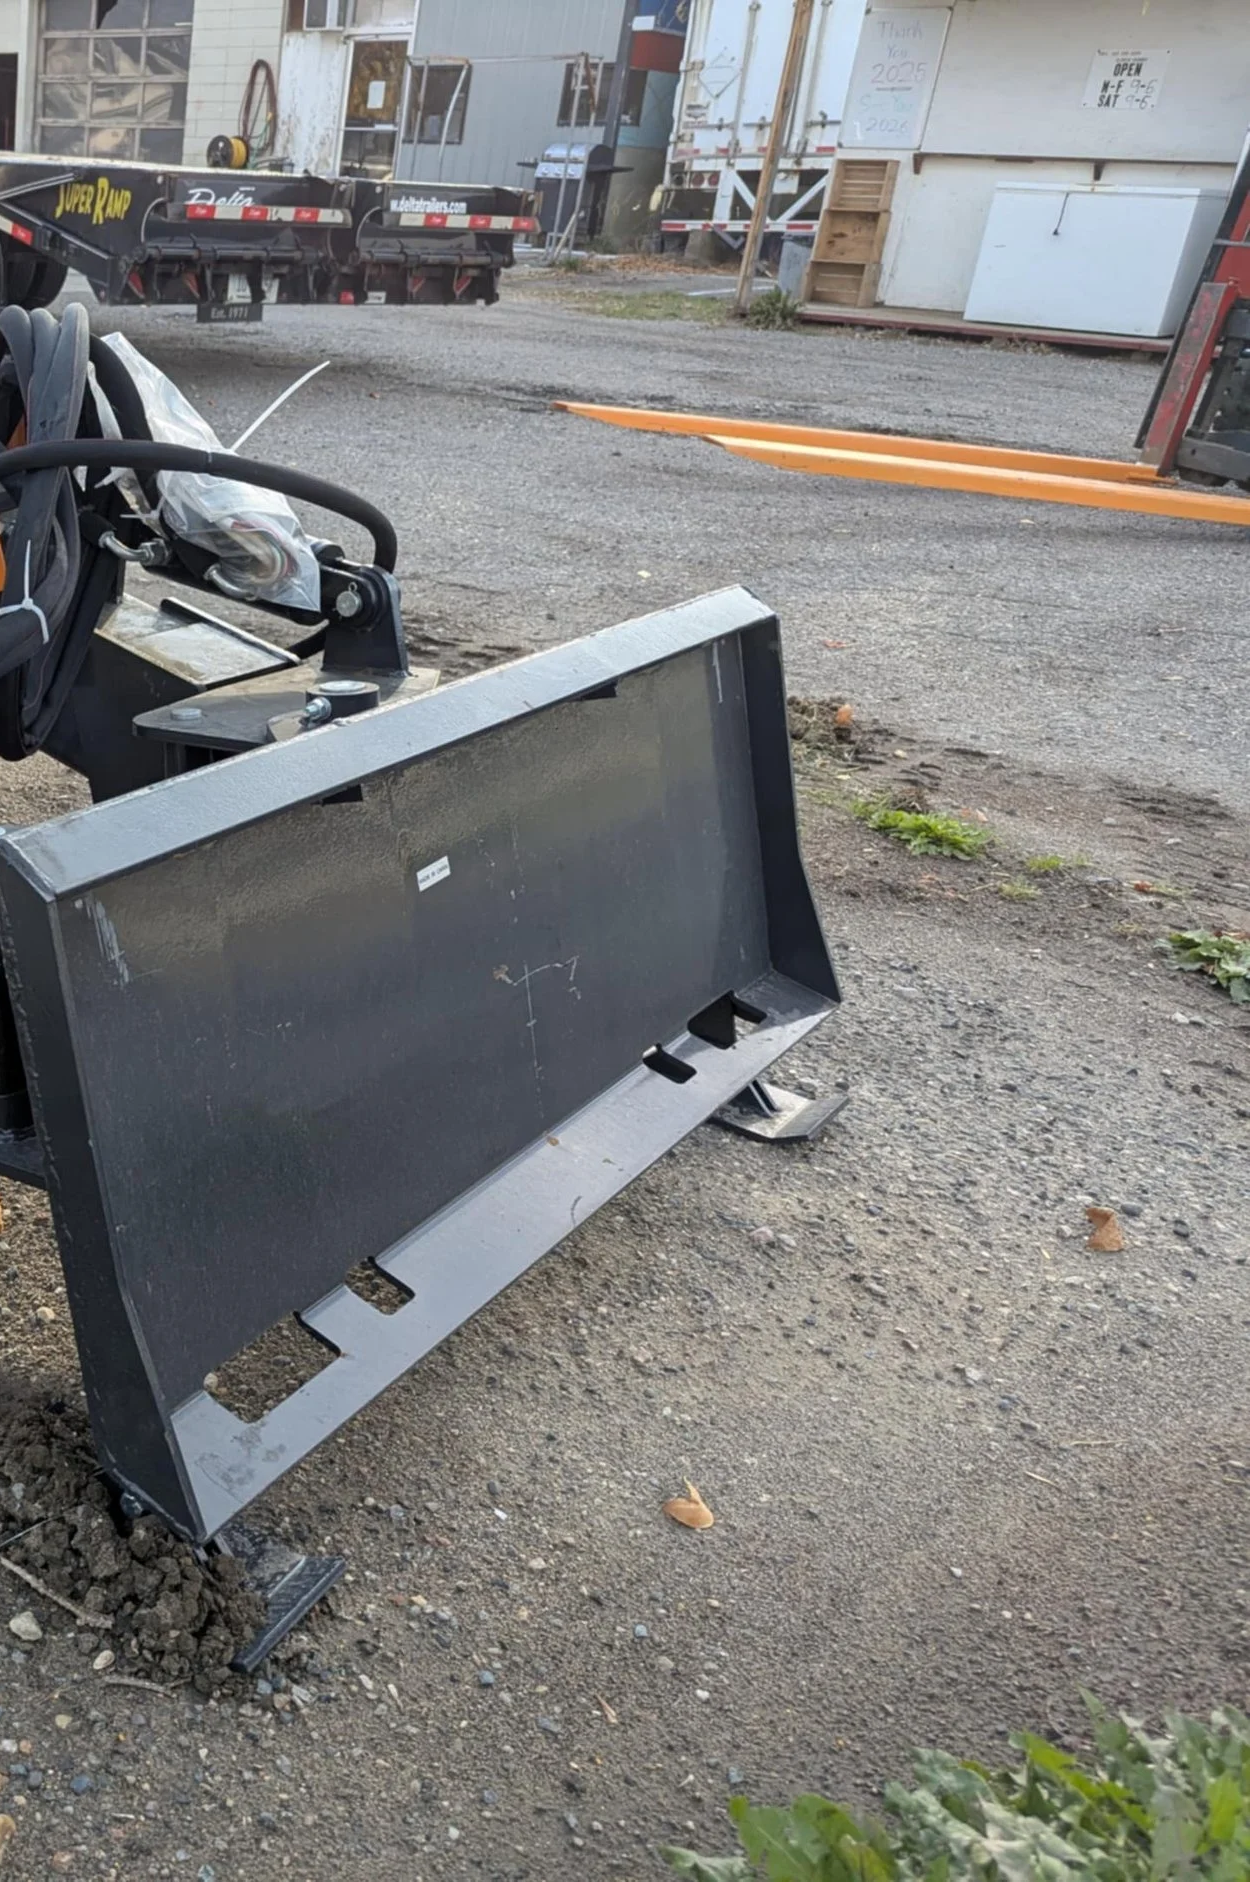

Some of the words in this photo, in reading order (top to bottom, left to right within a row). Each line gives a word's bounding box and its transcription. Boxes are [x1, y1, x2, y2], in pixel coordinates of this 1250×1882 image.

[877, 21, 922, 39] Thank
[887, 43, 908, 59] You
[871, 61, 928, 84] 2025
[1113, 62, 1143, 76] OPEN
[1097, 94, 1120, 108] SAT
